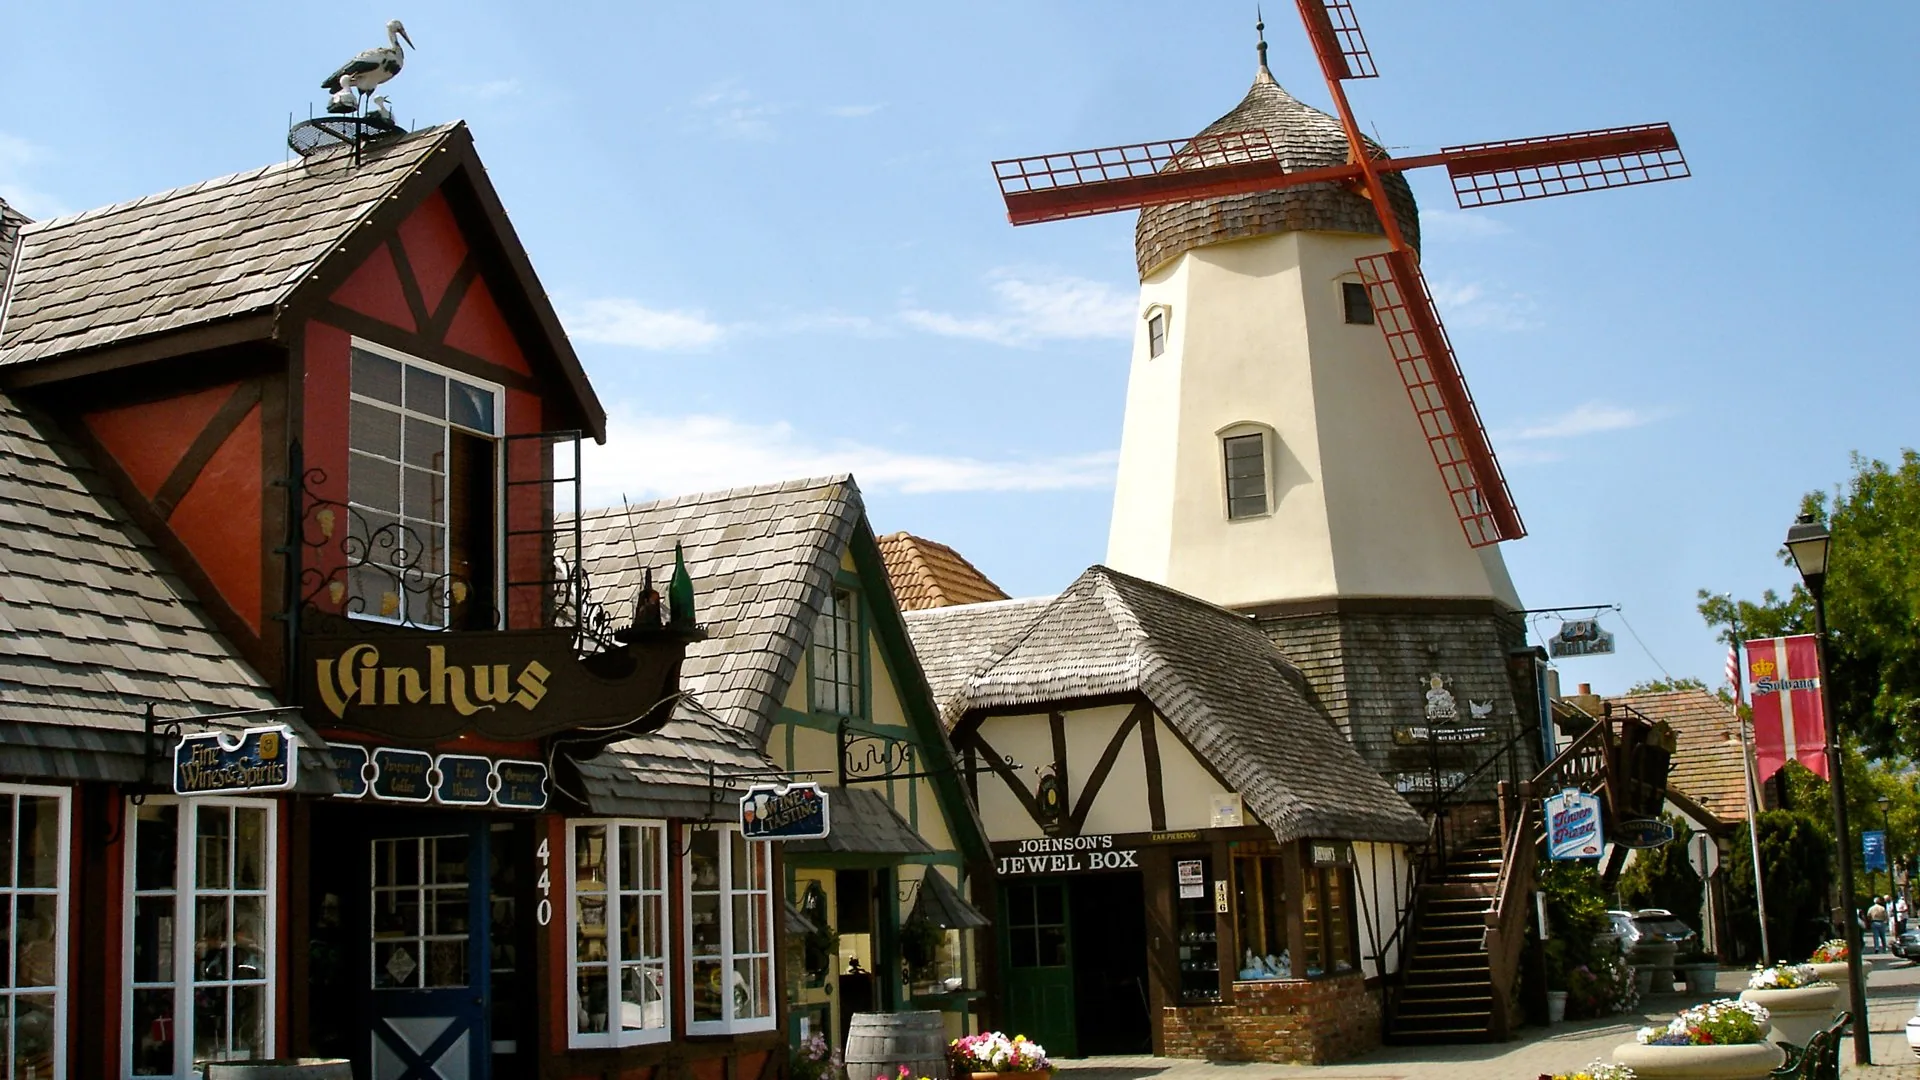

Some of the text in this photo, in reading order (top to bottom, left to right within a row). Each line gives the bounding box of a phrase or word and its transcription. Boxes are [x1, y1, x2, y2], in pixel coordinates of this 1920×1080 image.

[316, 643, 551, 719] Vinhus
[1756, 675, 1815, 696] Solvang
[191, 743, 221, 767] Fine
[765, 790, 801, 815] WINE
[765, 800, 818, 830] TASTING
[1553, 807, 1593, 828] Tower
[1018, 835, 1113, 853] JOHNSON'S
[1553, 821, 1596, 844] Pizza
[997, 850, 1139, 875] JEWEL BOX
[536, 838, 552, 926] 440
